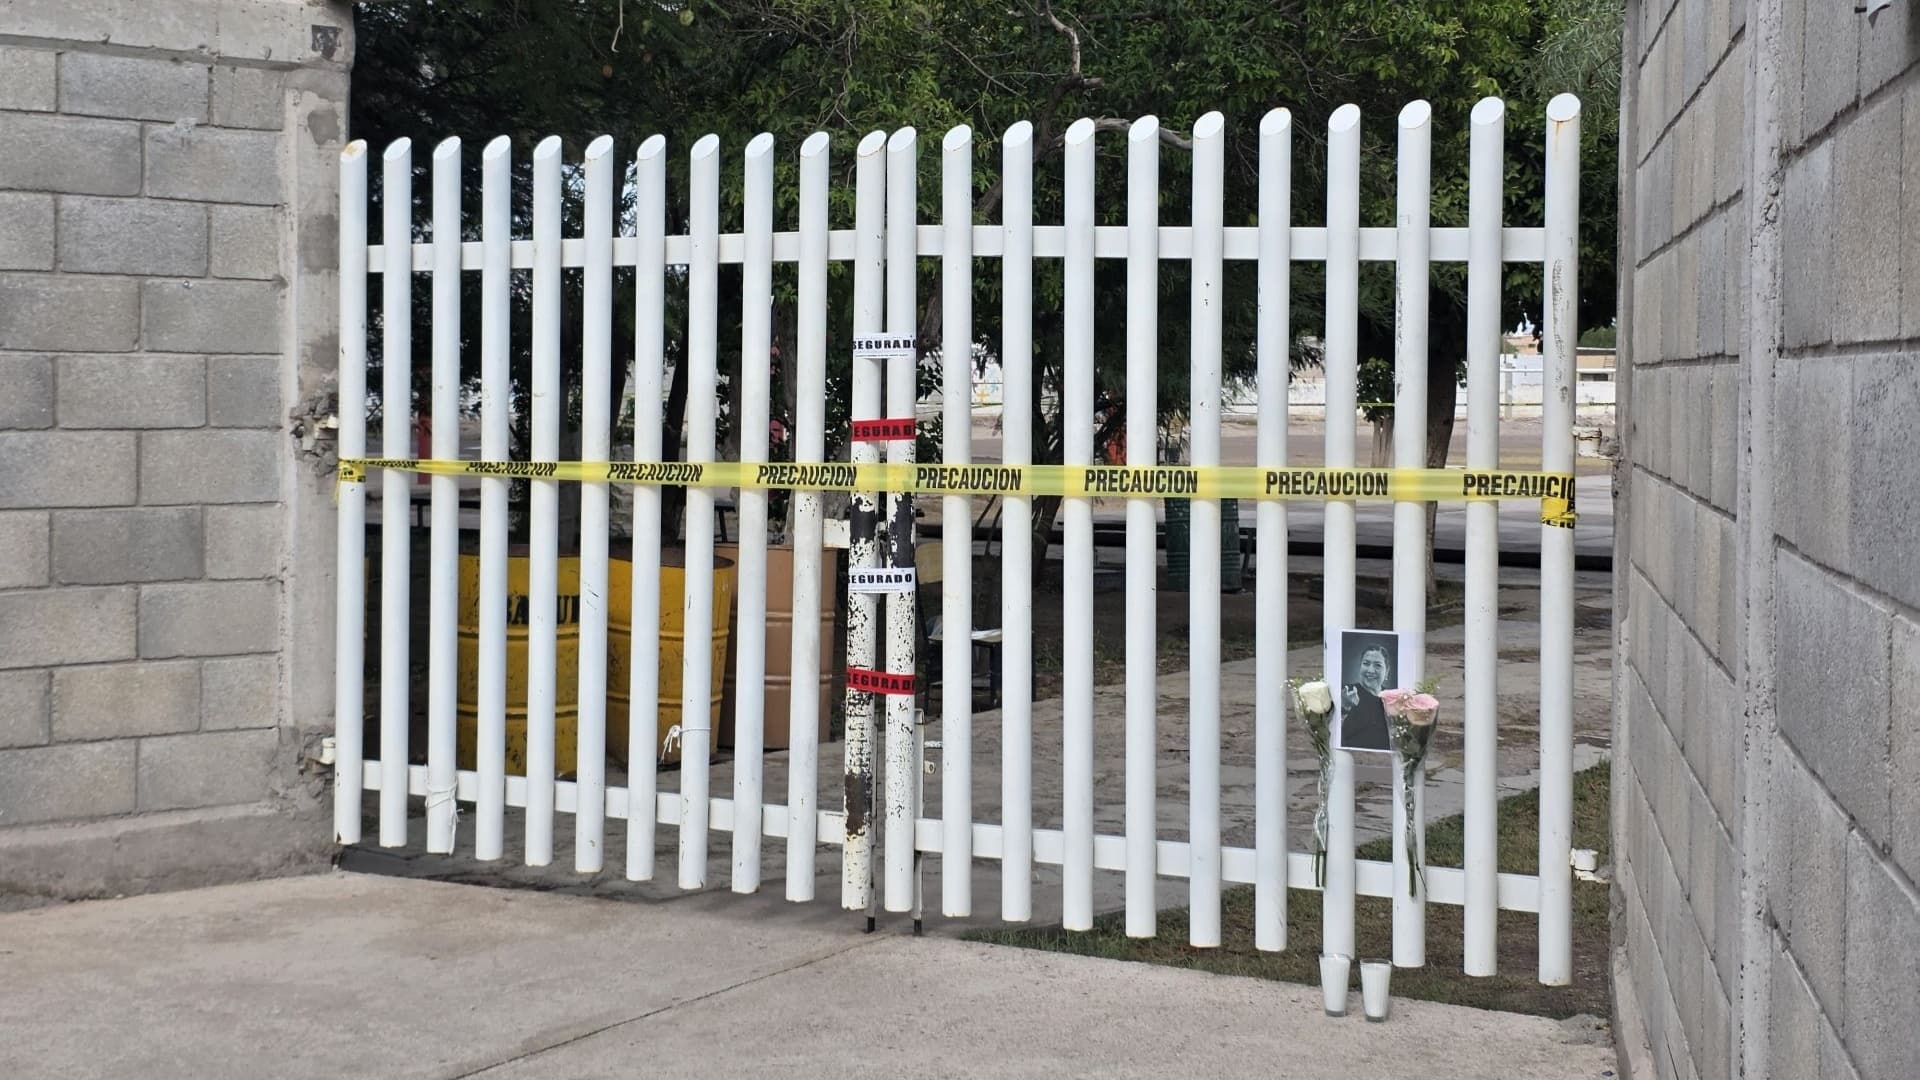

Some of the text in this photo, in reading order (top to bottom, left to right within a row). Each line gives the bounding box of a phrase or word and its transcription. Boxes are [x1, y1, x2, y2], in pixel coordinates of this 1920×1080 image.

[607, 463, 703, 482] PRECAUCION
[756, 465, 857, 486] PRECAUCION
[915, 467, 1022, 490] PRECAUCION
[1084, 469, 1198, 493] PRECAUCION
[1265, 471, 1388, 495] PRECAUCION
